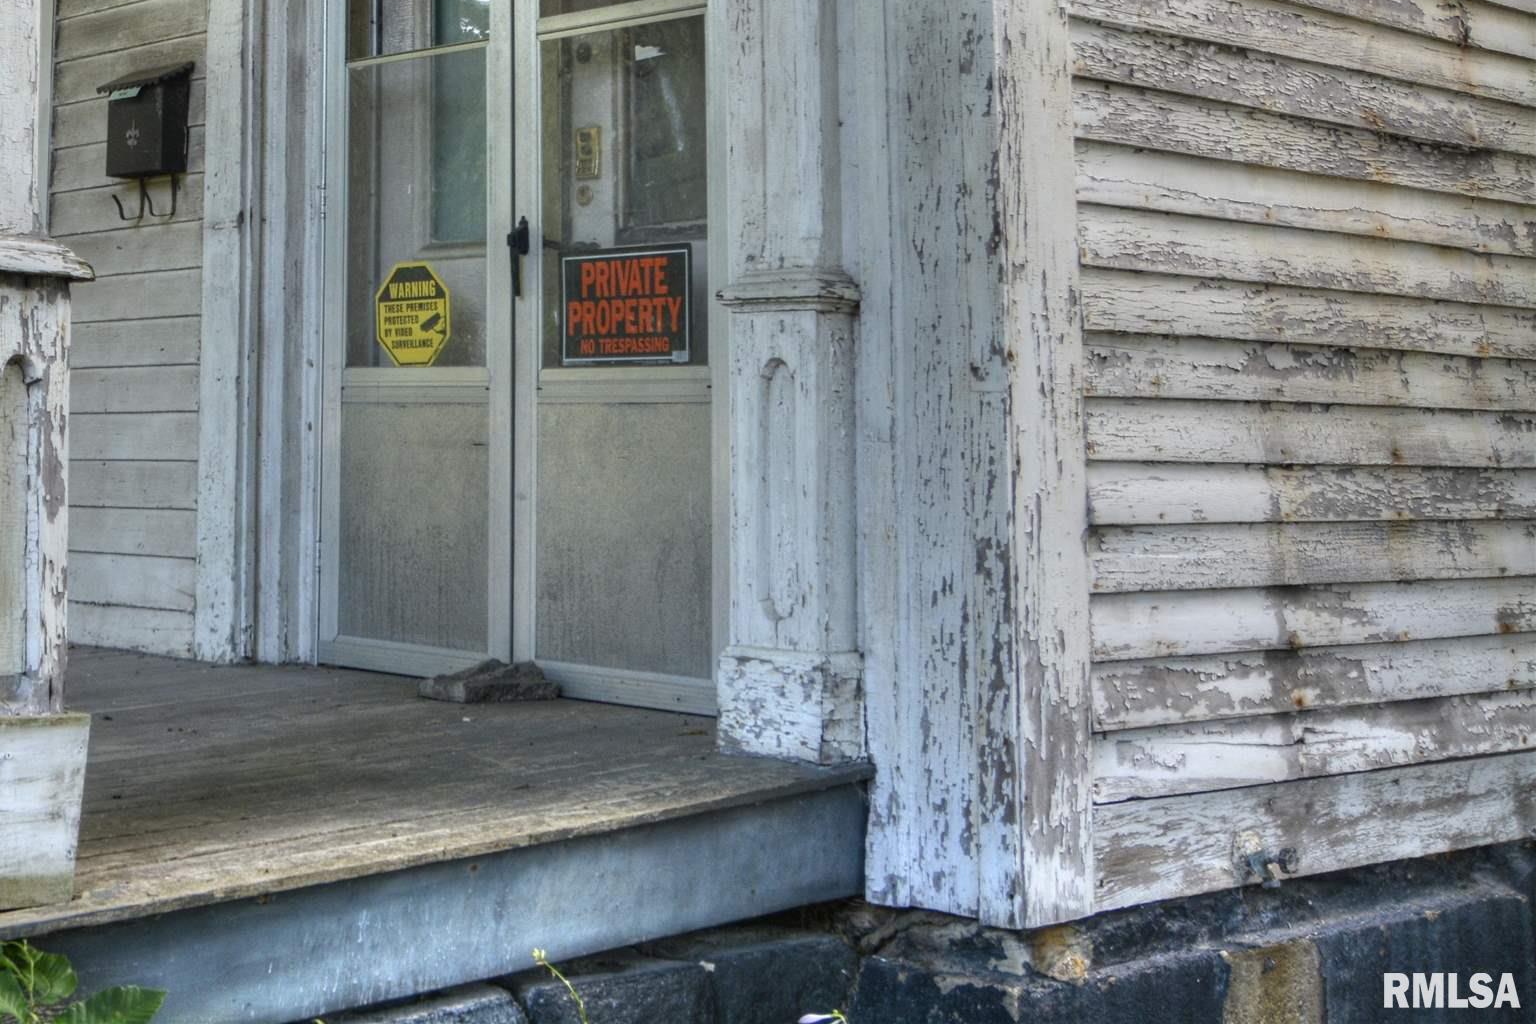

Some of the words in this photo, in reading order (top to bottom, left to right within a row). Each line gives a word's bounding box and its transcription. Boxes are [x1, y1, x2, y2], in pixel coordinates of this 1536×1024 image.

[580, 257, 669, 298] PRIVATE
[389, 279, 436, 299] WARNING
[384, 304, 404, 313] THESE
[406, 301, 438, 312] PREMISES
[384, 315, 419, 326] PROTECTED
[568, 297, 681, 336] PROPERTY
[384, 328, 392, 338] BY
[395, 327, 413, 337] VIDEO
[391, 338, 434, 349] SURVEILLANCE
[580, 339, 595, 354] NO
[599, 336, 670, 354] TRESPASSING
